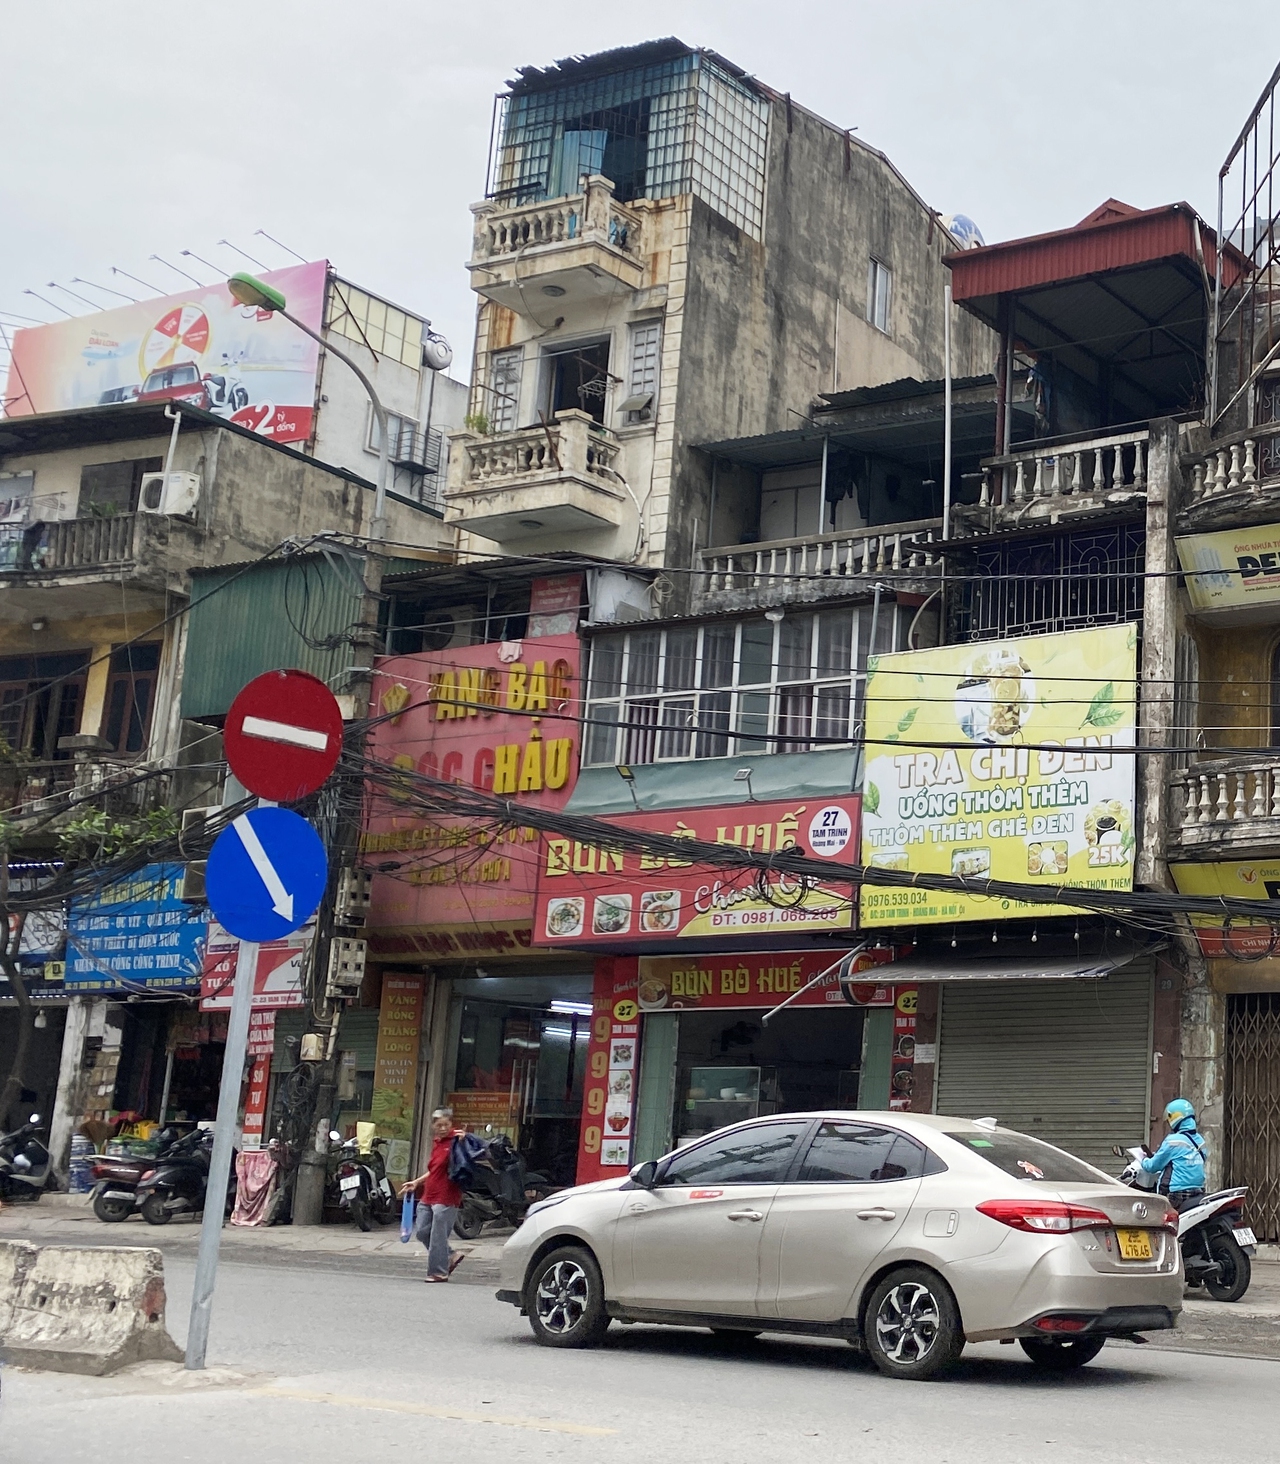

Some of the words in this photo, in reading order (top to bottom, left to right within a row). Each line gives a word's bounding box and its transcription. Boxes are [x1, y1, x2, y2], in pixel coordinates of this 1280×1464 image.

[254, 400, 275, 435] 2
[276, 421, 296, 432] đồng
[971, 744, 1030, 785] CHỊ
[1038, 735, 1112, 776] ĐEN
[898, 787, 957, 819] UỐNG
[961, 784, 1023, 813] THÒM
[1027, 777, 1088, 807] THÈM
[822, 811, 839, 826] 27
[812, 829, 826, 838] TAM
[828, 828, 848, 837] TRINH
[869, 822, 924, 847] THÒM
[929, 819, 983, 843] THÈM
[987, 813, 1027, 840] GHÉ
[1032, 813, 1075, 836] ĐEN
[1088, 844, 1129, 868] 25K
[868, 891, 928, 908] 0976.539.034
[711, 912, 737, 927] ĐT:
[671, 965, 713, 996] BÚN
[720, 962, 750, 995] BÒ
[756, 957, 806, 994] HUẾ
[1162, 981, 1172, 989] 29
[388, 995, 417, 1005] VÀNG
[618, 1005, 633, 1016] 27
[384, 1043, 412, 1052] LONG
[253, 1066, 264, 1083] SỐ
[251, 1090, 262, 1107] TỰ
